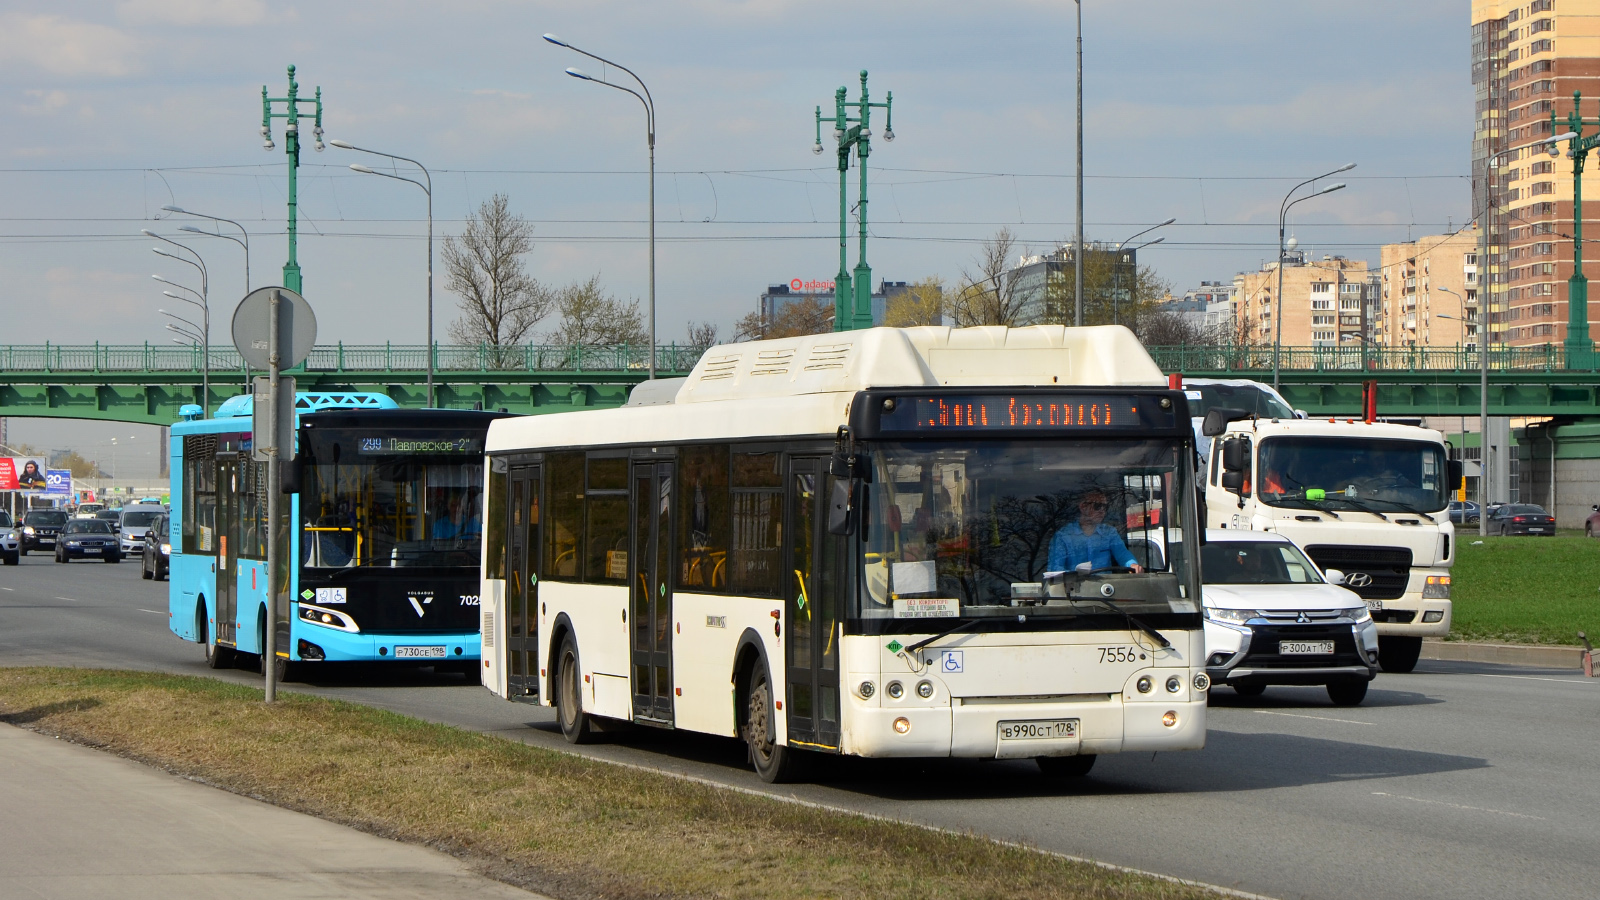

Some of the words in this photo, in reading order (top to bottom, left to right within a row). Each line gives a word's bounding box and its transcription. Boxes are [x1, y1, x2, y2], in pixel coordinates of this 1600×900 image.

[804, 279, 836, 290] adagio
[362, 438, 382, 450] 299
[1097, 646, 1136, 664] 7556
